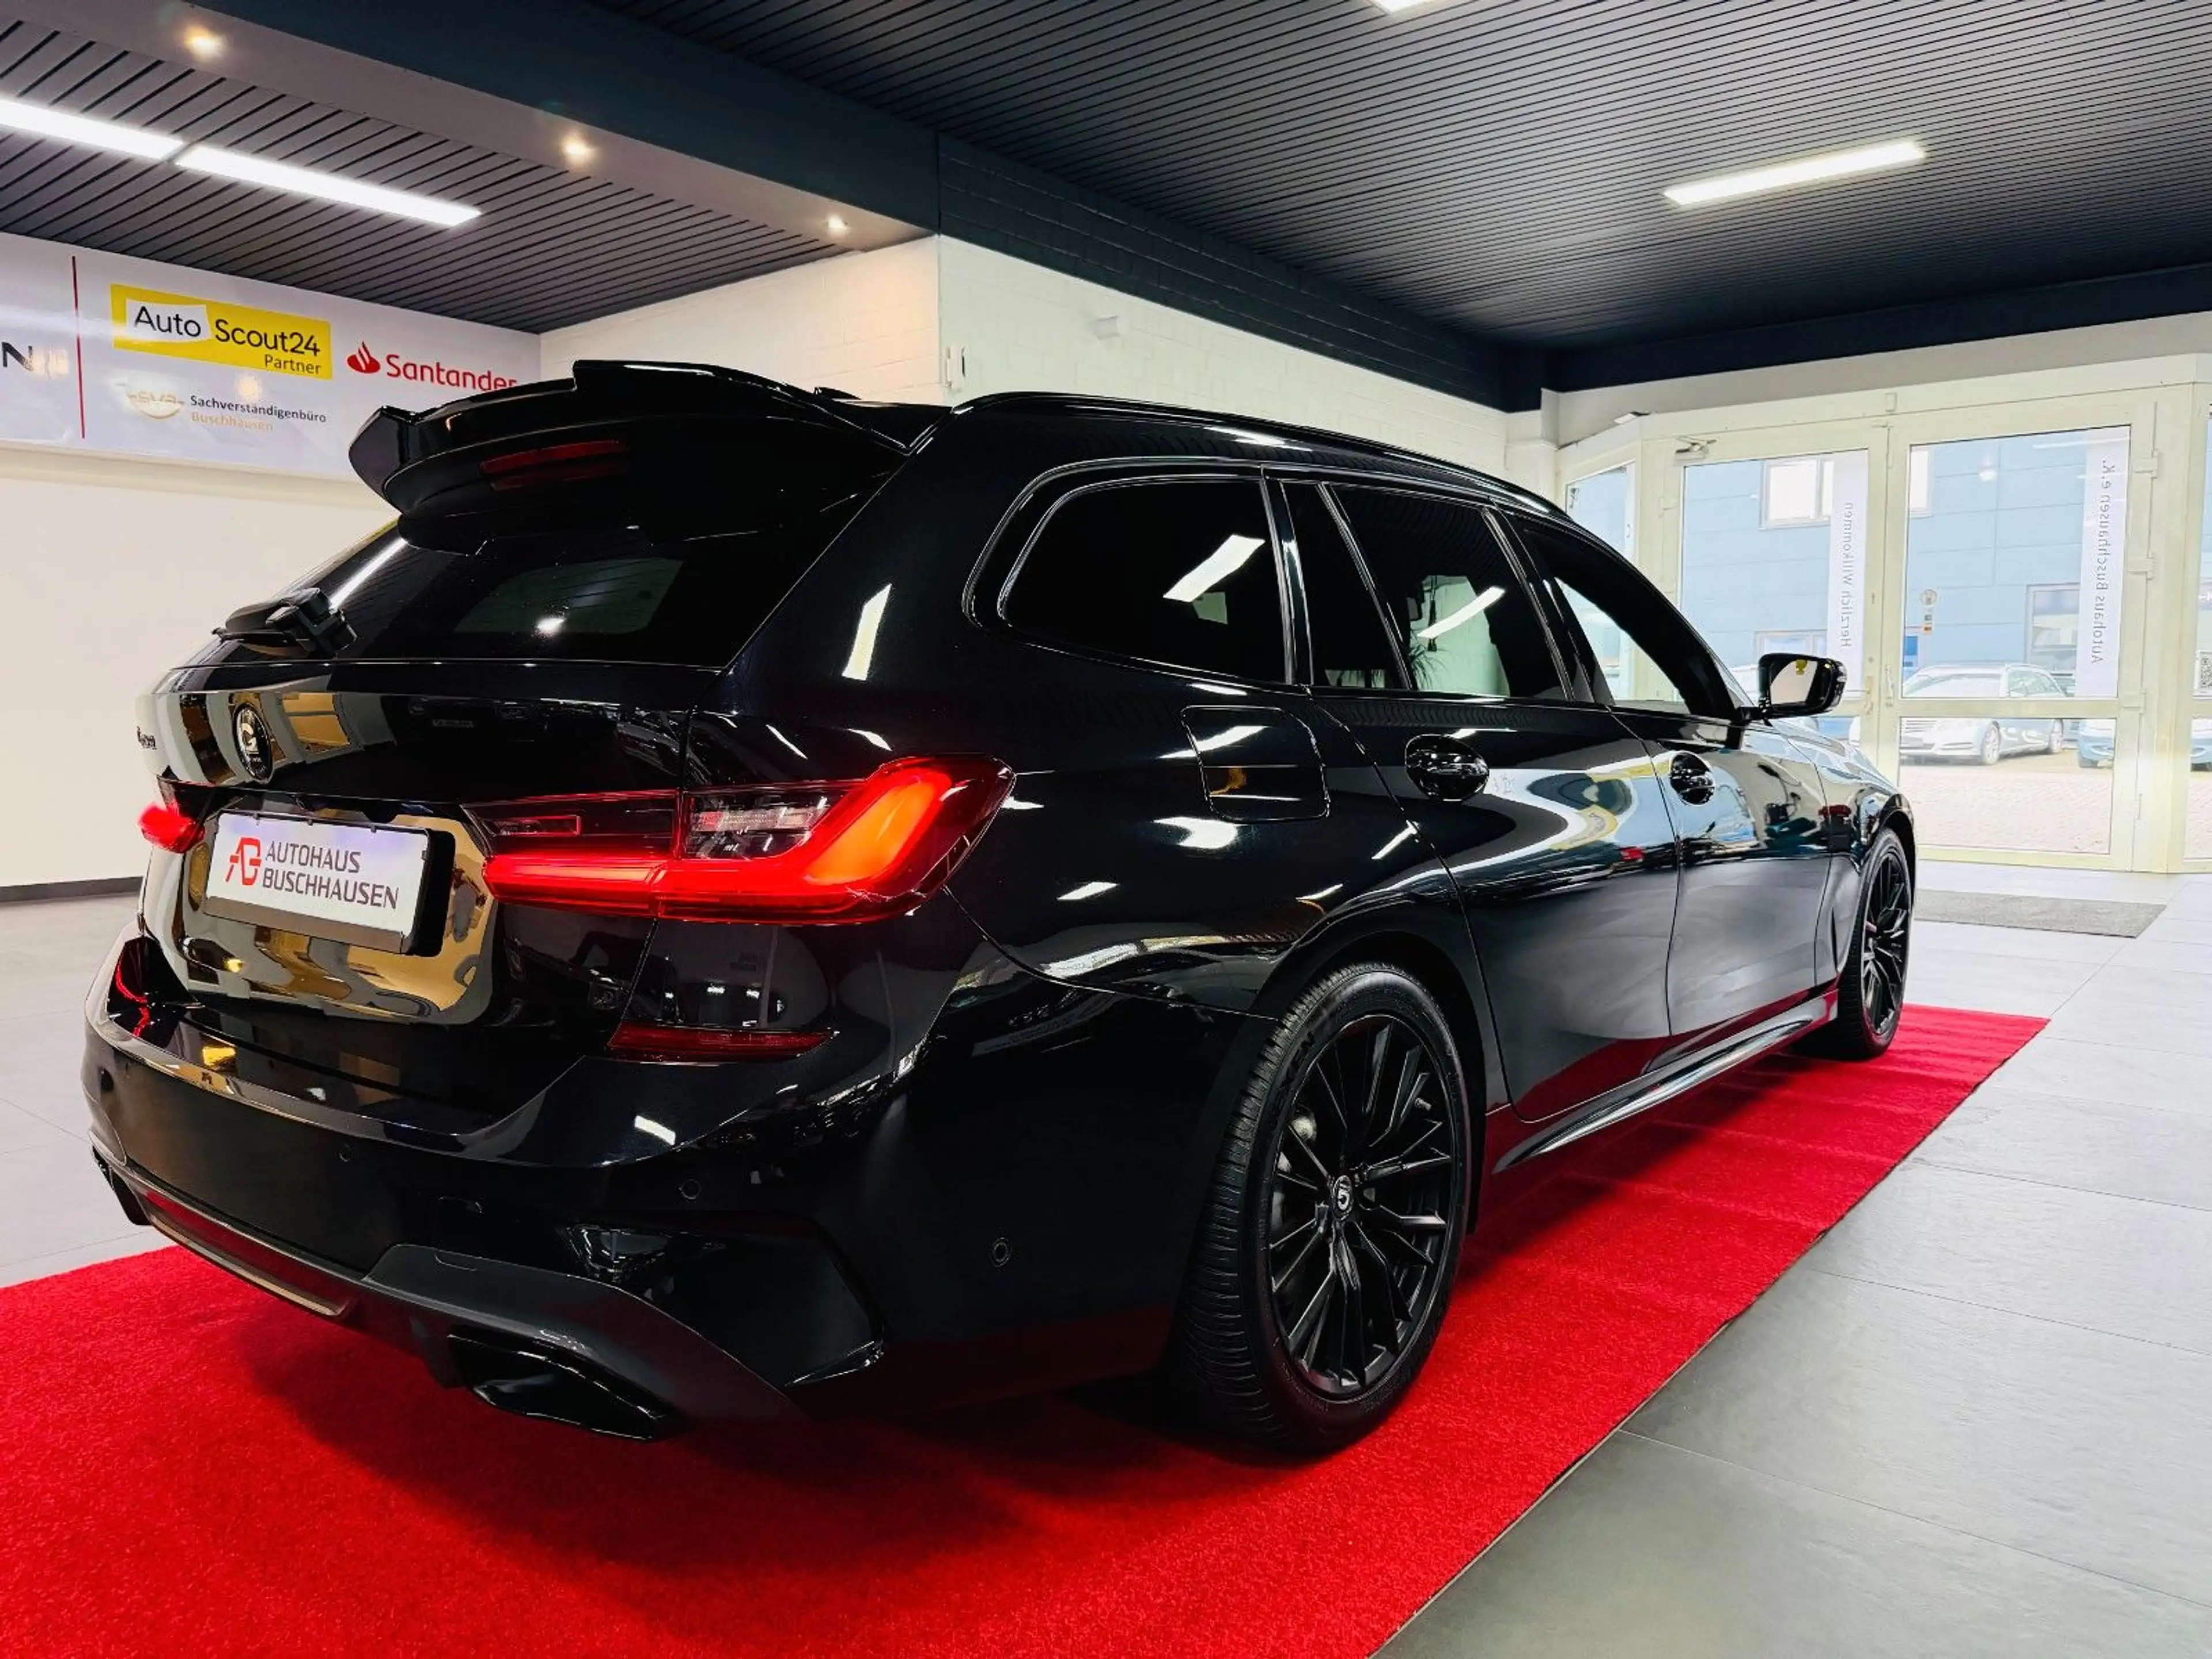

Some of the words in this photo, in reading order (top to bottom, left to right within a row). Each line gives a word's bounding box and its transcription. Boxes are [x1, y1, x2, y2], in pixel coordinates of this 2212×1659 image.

[134, 306, 202, 338] Auto
[215, 319, 321, 357] Scout24
[264, 354, 321, 375] Partner
[190, 395, 327, 423] Sachverständigenbüro
[264, 840, 362, 874] AUTOHAUS
[262, 867, 400, 910] BUSCHHAUSEN
